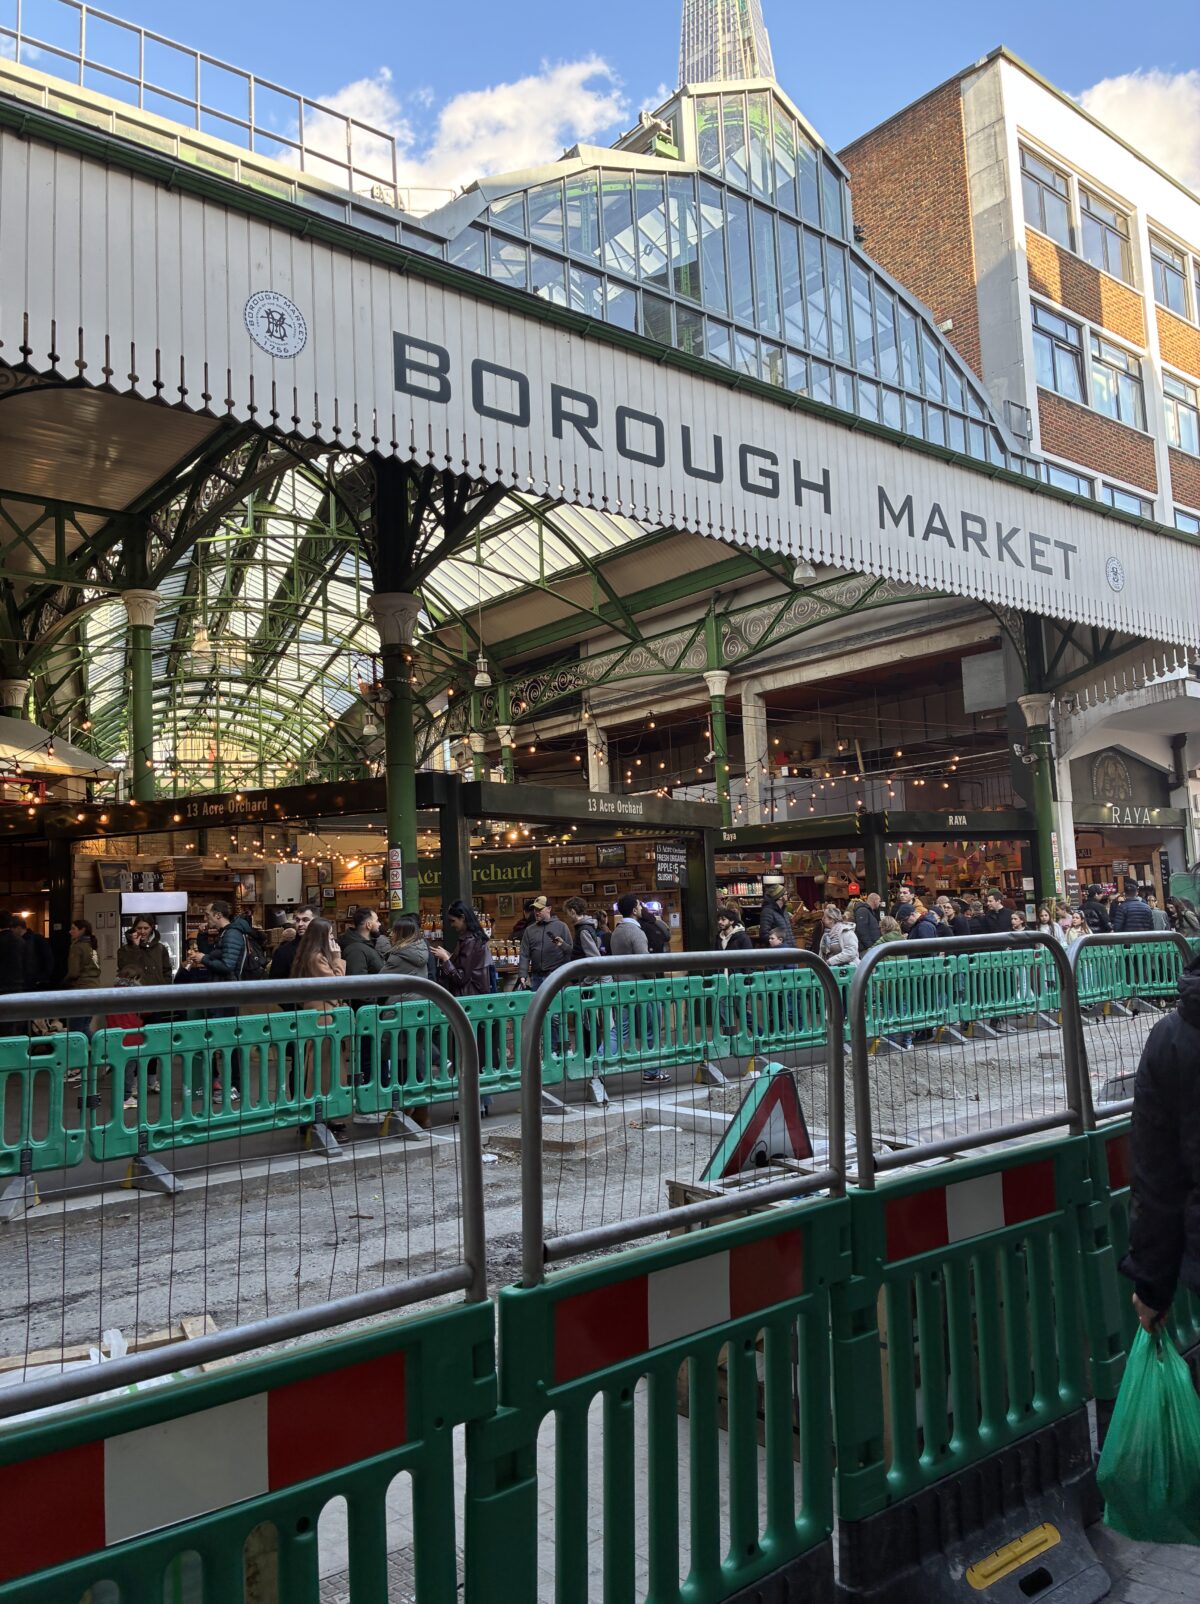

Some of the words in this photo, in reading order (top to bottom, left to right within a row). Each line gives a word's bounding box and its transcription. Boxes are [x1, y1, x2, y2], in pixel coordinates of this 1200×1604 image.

[248, 294, 279, 327] BOROUGH
[283, 300, 305, 343] MARKET
[393, 331, 832, 514] BOROUGH
[877, 485, 1077, 580] MARKET
[187, 803, 198, 817] 13
[203, 802, 224, 816] Acre
[229, 797, 268, 813] Orchard
[588, 799, 597, 812] 13
[600, 799, 615, 813] Acre
[617, 800, 643, 814] Orchard
[1112, 806, 1151, 824] RAYA
[948, 815, 968, 826] RAYA
[472, 861, 533, 882] rchard
[657, 863, 673, 872] APPLE
